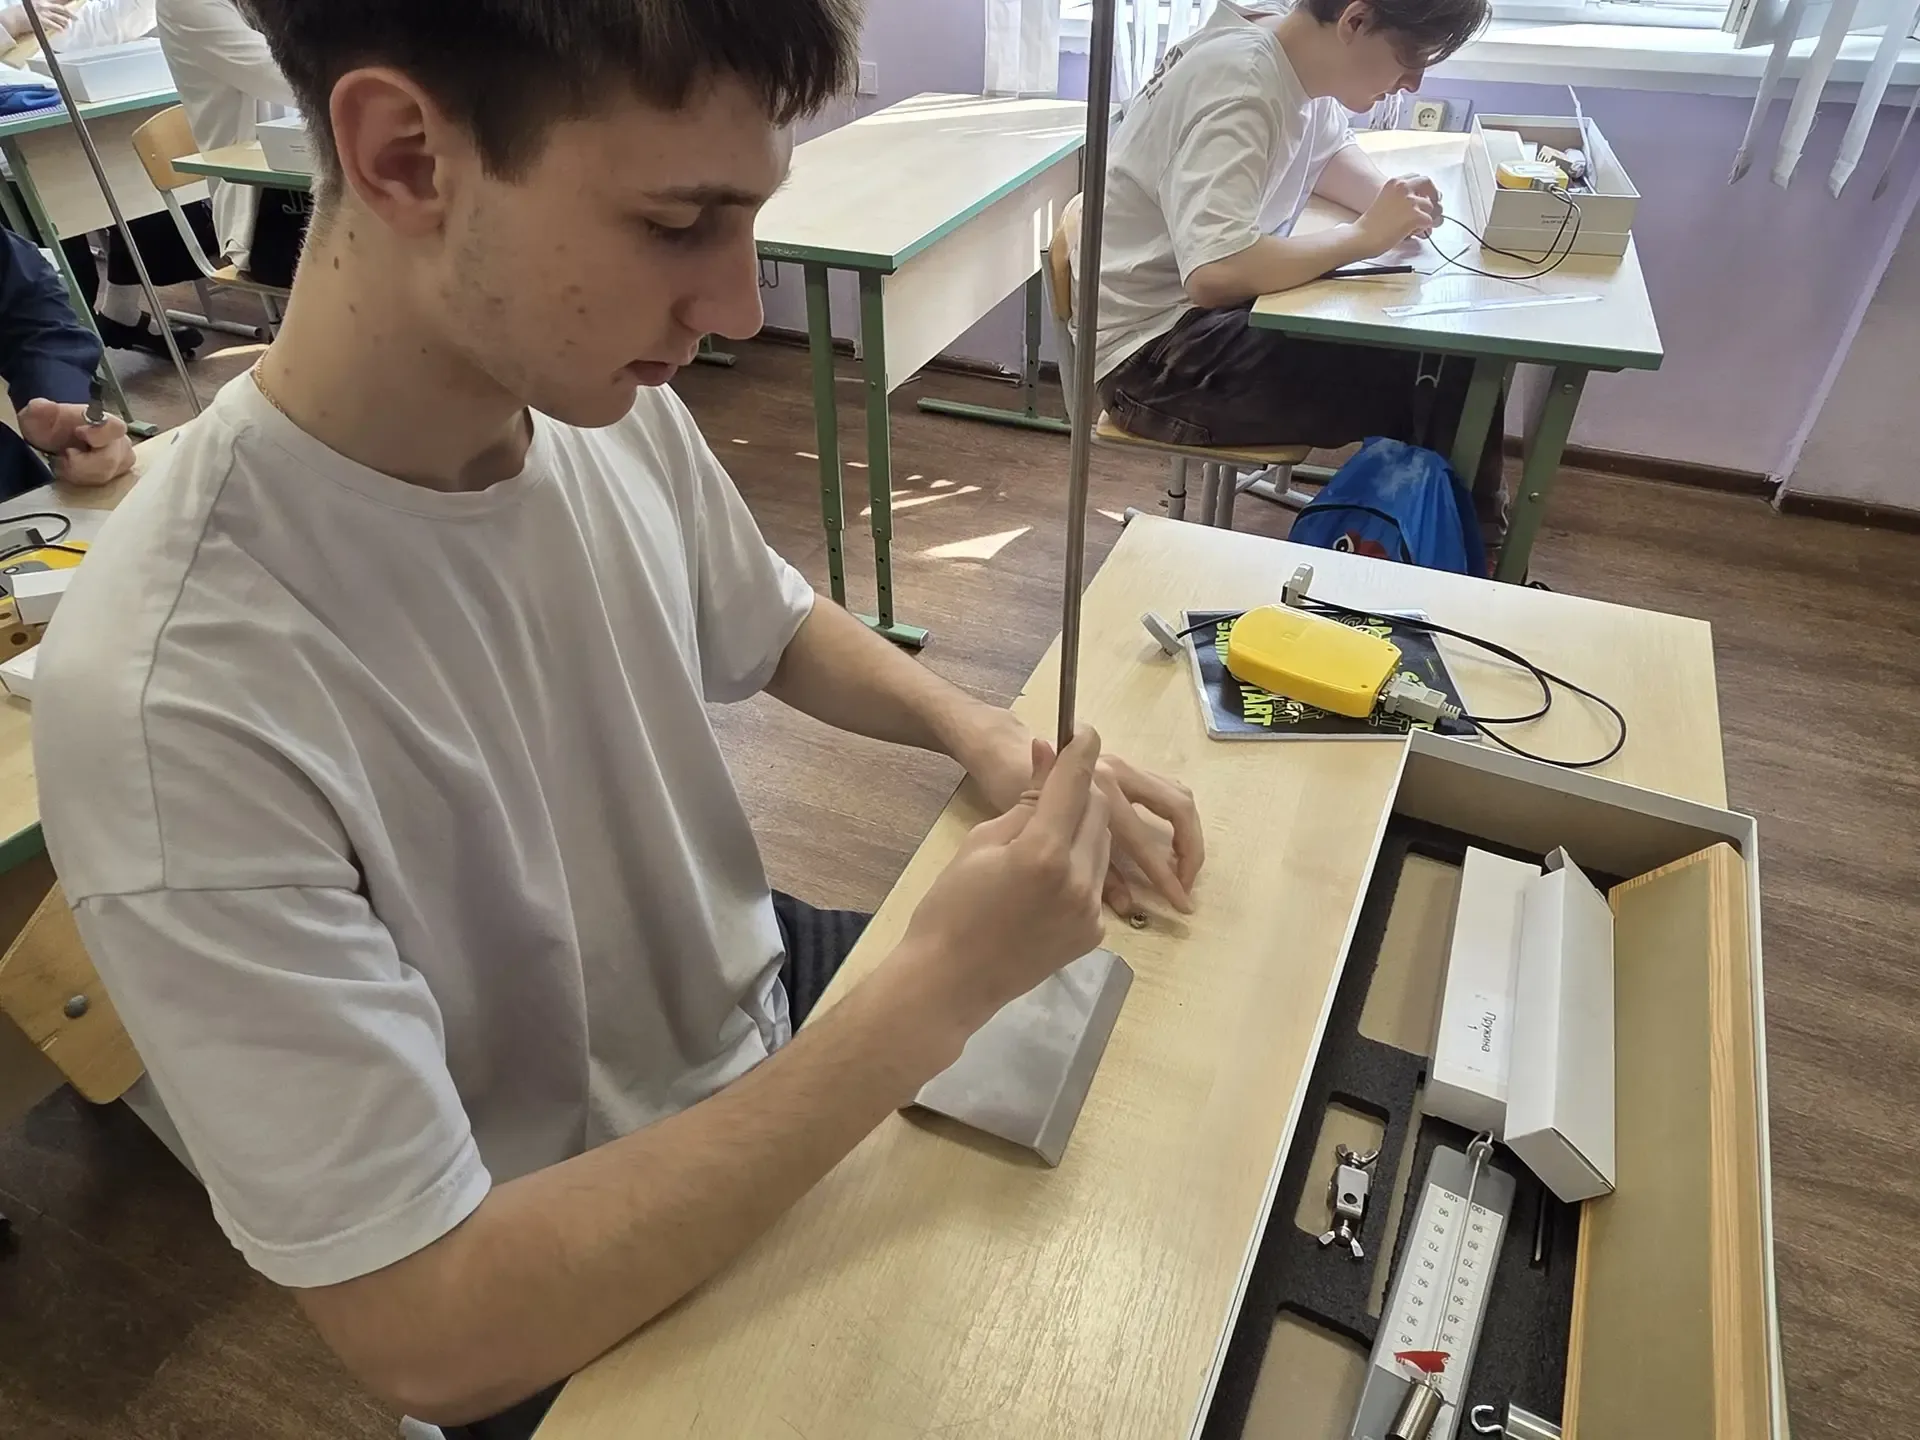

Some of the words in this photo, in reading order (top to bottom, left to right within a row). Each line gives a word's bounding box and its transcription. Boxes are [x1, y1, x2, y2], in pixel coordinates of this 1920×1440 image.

[1480, 1011, 1496, 1052] Пружина
[1444, 1192, 1458, 1203] 100
[1438, 1208, 1449, 1217] 90
[1434, 1225, 1444, 1235] 80
[1428, 1242, 1439, 1252] 70
[1423, 1260, 1434, 1270] 60
[1418, 1278, 1429, 1288] 50
[1412, 1296, 1424, 1306] 40
[1406, 1315, 1419, 1326] 30
[1401, 1335, 1413, 1345] 20
